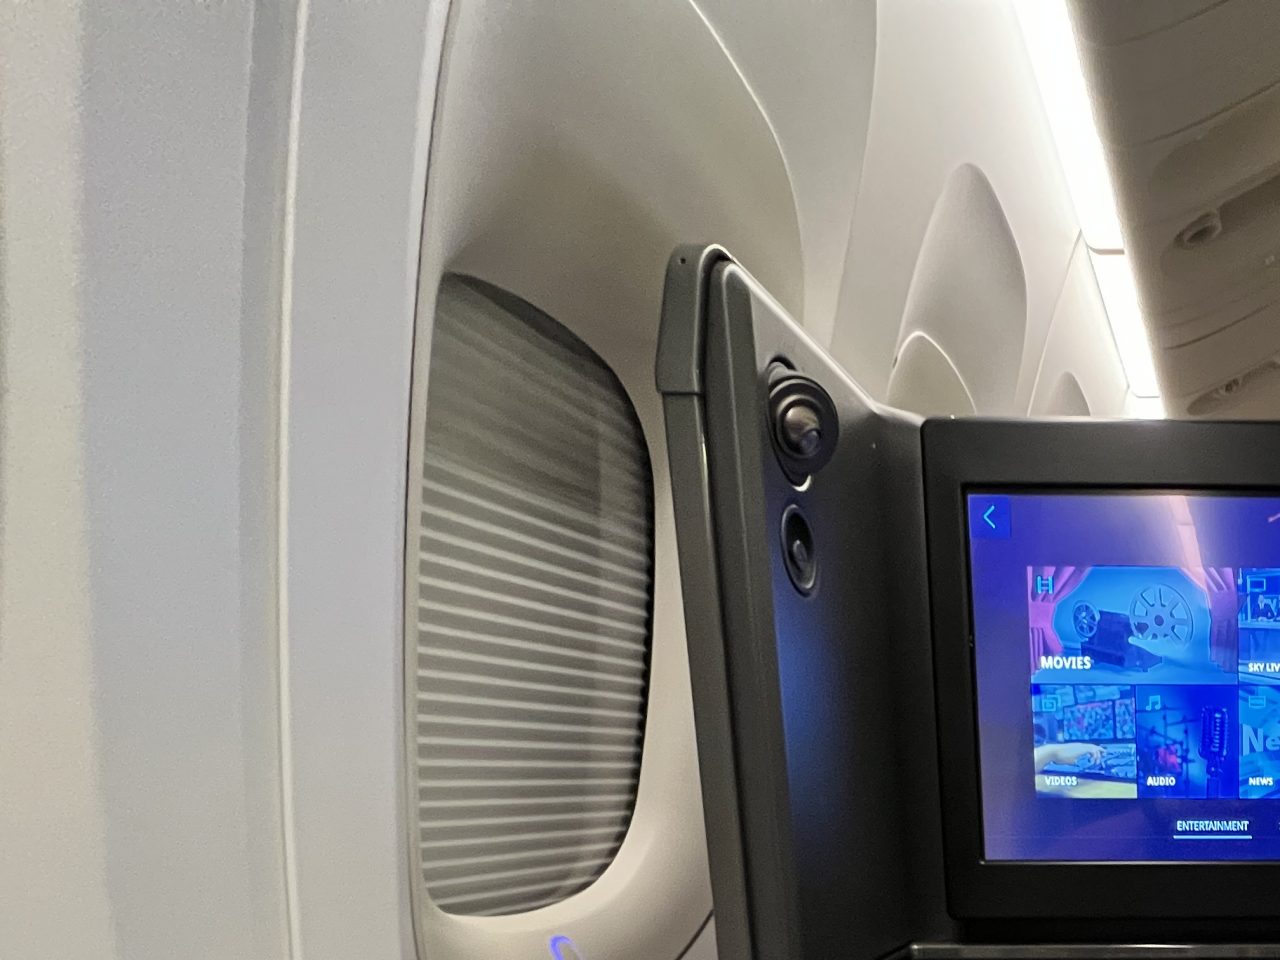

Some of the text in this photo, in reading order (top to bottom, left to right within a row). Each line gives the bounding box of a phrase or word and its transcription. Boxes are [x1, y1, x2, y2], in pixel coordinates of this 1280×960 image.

[1040, 655, 1092, 669] MOVIES
[1248, 662, 1265, 673] SKY
[1045, 776, 1078, 786] VIDEOS
[1146, 776, 1176, 786] AUDIO
[1248, 777, 1274, 786] NEWS
[1176, 820, 1250, 832] ENTERTAINMENT
